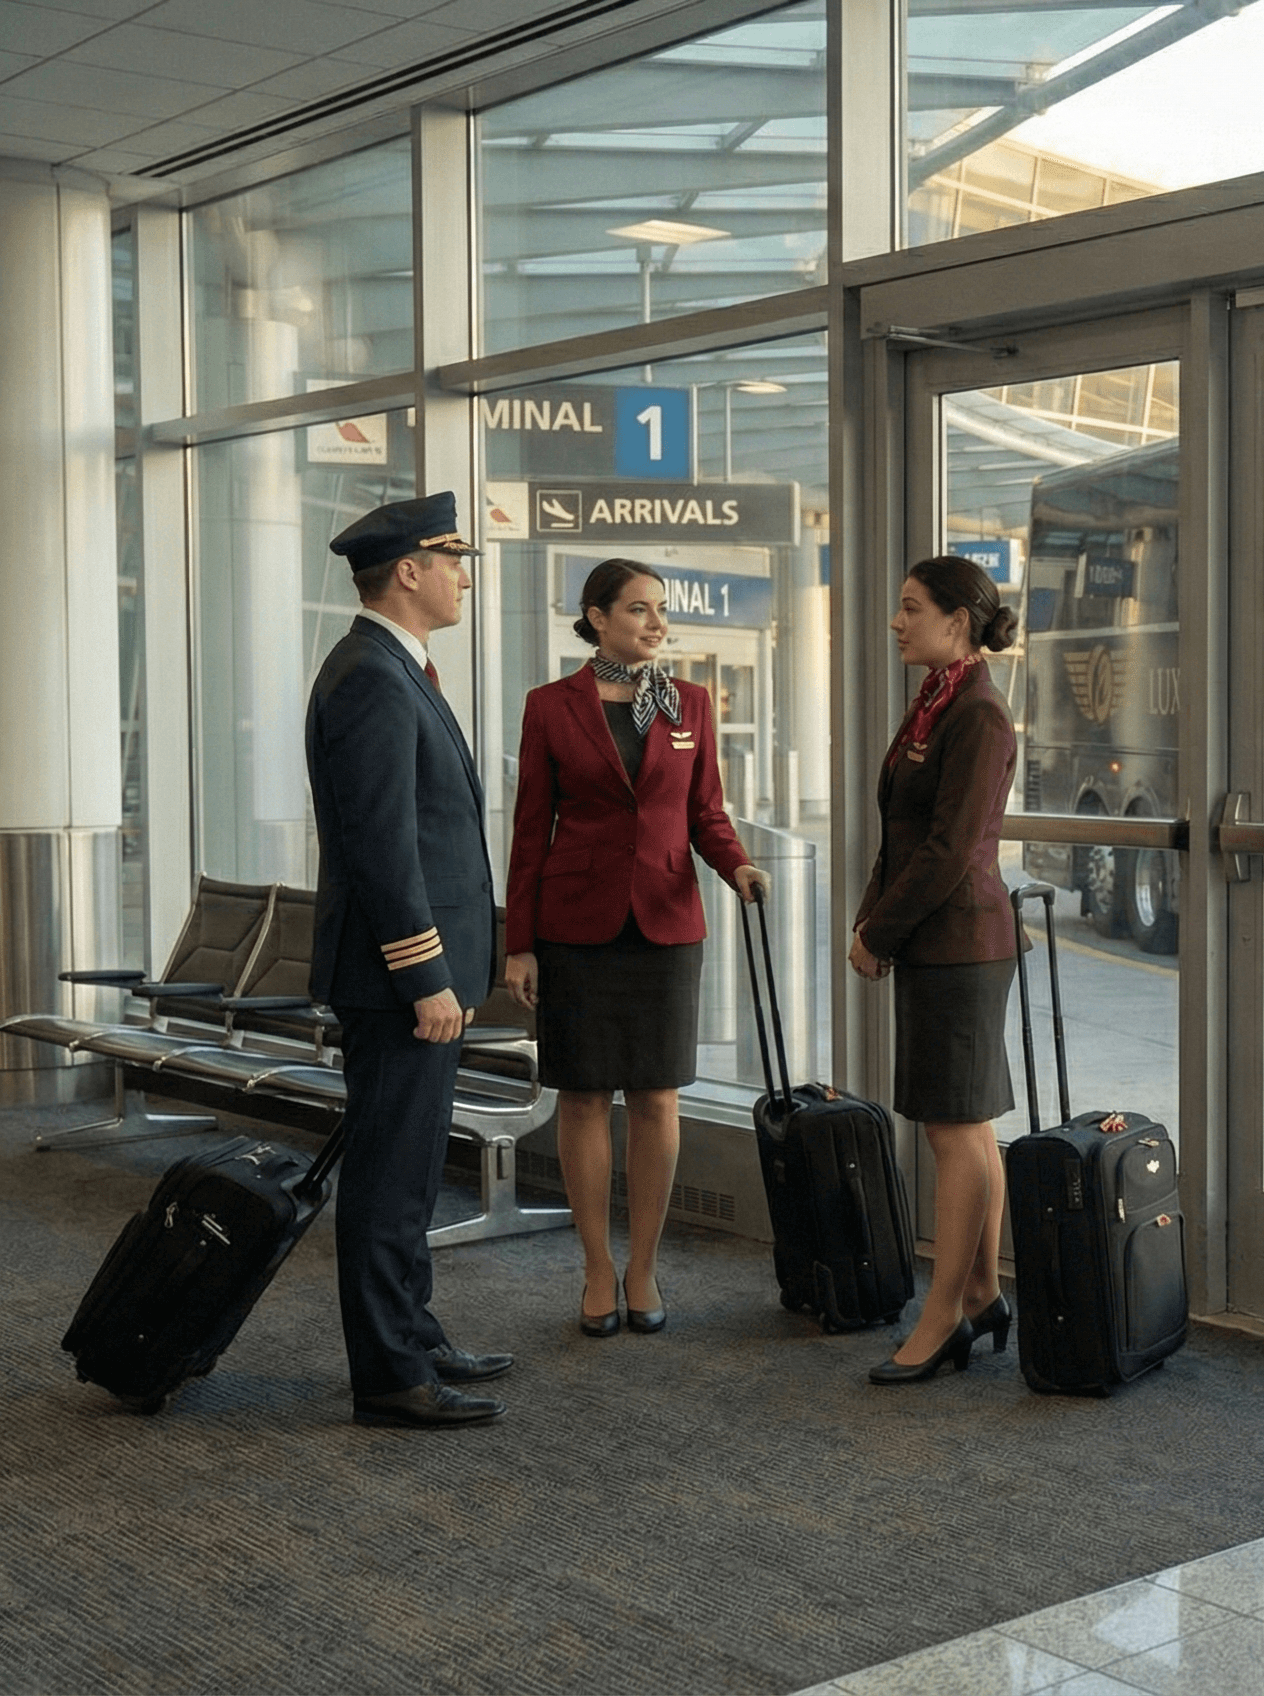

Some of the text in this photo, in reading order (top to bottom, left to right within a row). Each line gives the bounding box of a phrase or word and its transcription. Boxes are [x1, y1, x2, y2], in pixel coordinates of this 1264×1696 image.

[480, 398, 662, 460] MINAL 1
[589, 499, 739, 526] ARRIVALS
[720, 583, 729, 617] 1
[1149, 667, 1181, 715] LUX
